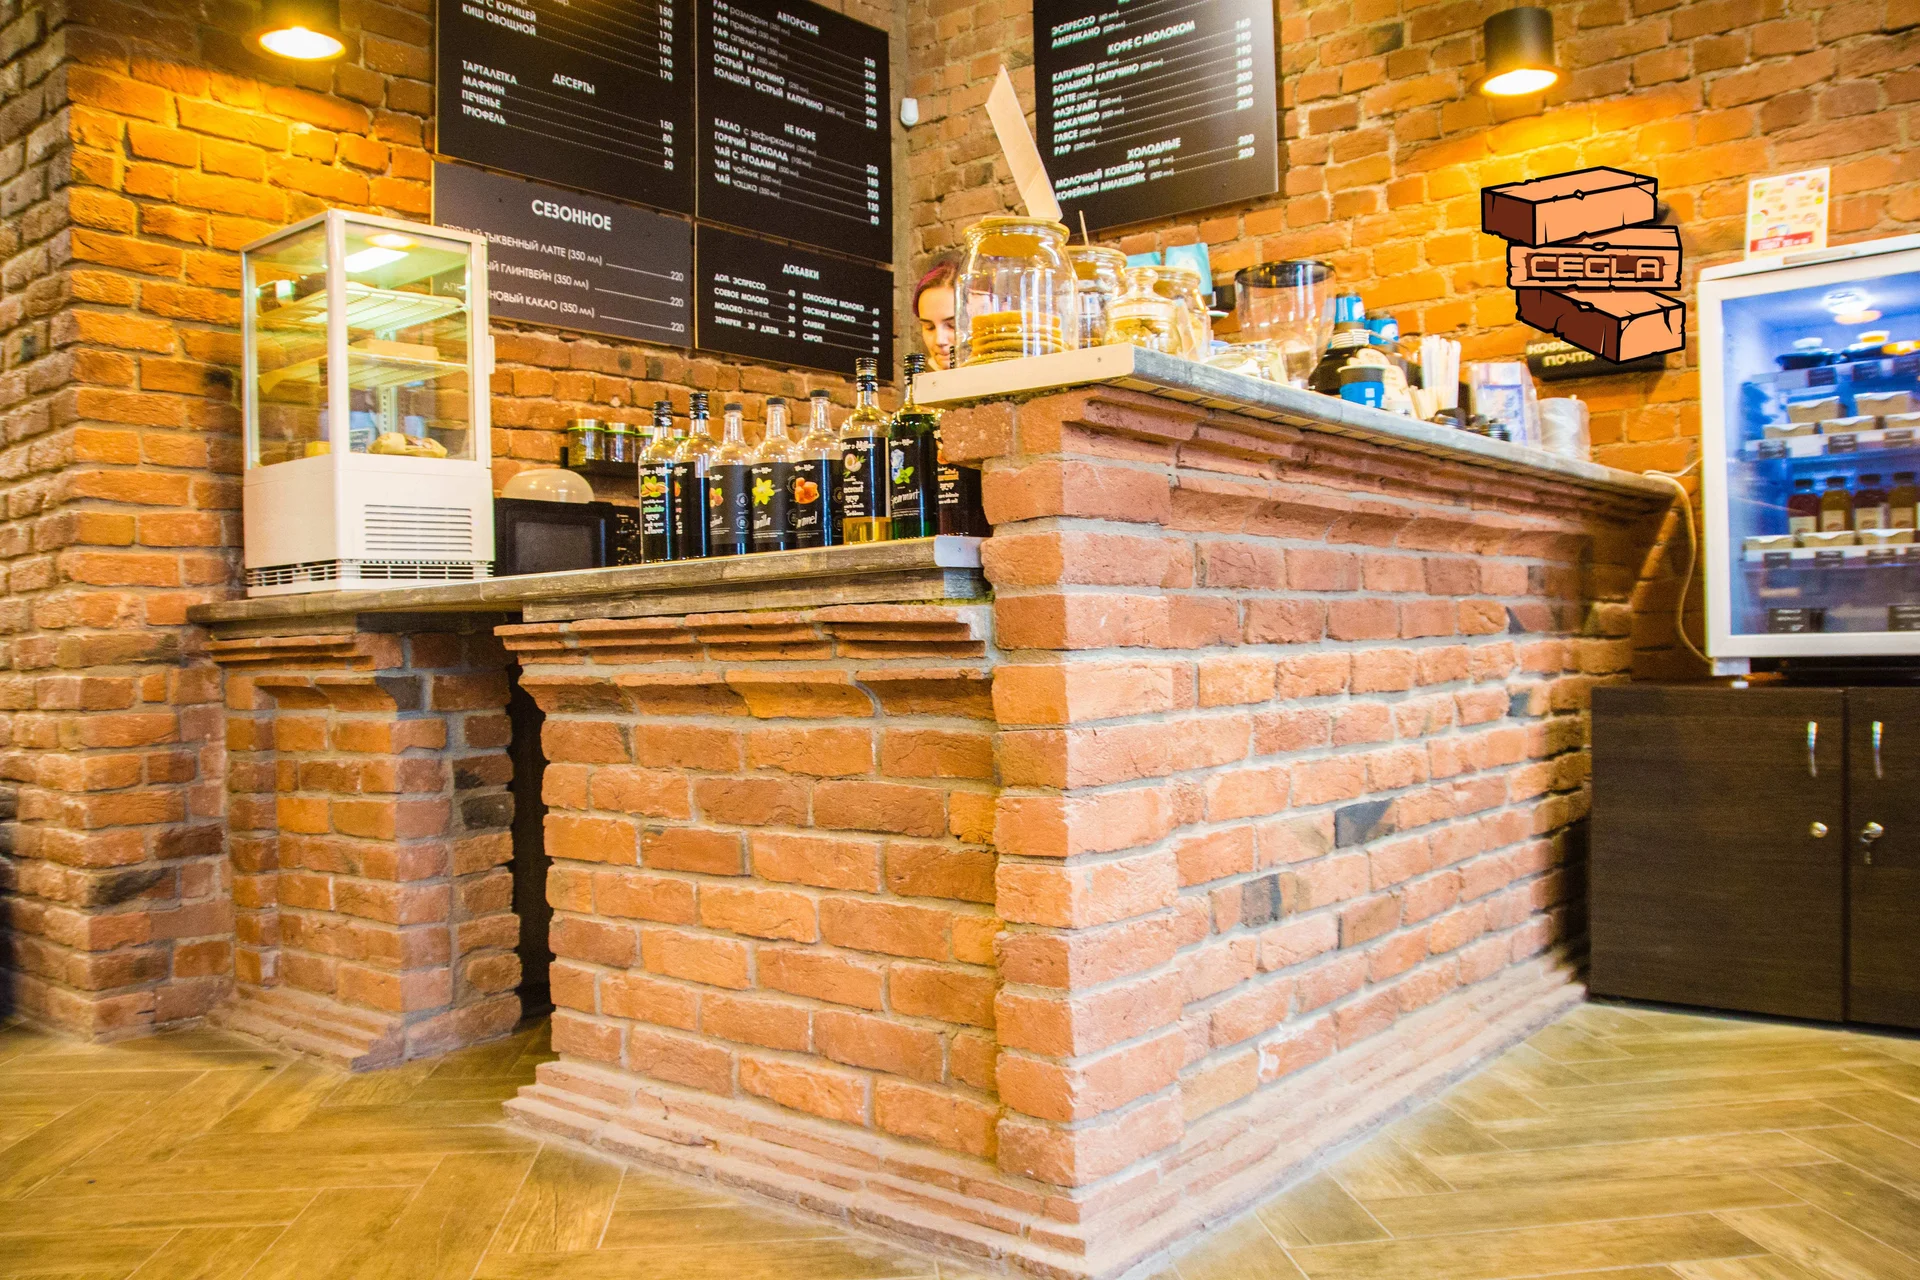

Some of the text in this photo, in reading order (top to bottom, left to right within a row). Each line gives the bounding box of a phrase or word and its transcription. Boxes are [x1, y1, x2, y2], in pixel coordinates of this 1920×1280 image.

[462, 3, 536, 36] КИШ ОВОЩНОЙ
[496, 0, 536, 21] КУРИЦЕЙ
[659, 5, 673, 18] 150
[713, 12, 729, 25] РАФ
[659, 17, 672, 30] 190
[713, 25, 729, 39] РАФ
[777, 11, 820, 36] АВТОРСКИЕ
[1051, 15, 1096, 37] ЭСПРЕССО
[659, 30, 672, 43] 170
[1051, 26, 1101, 49] АМЕРИКАНО
[1106, 20, 1195, 56] КОФЕ С МОЛОКОМ
[658, 42, 672, 55] 150
[713, 39, 739, 56] VEGAN
[659, 56, 673, 68] 190
[713, 53, 744, 71] ОСТРЫЙ
[747, 65, 785, 85] КАПУЧИНО
[552, 73, 595, 94] ДЕСЕРТЫ
[660, 69, 673, 81] 170
[1052, 62, 1095, 84] КАПУЧИНО
[1052, 74, 1094, 96] БОЛЬШОЙ
[1094, 63, 1140, 85] КАПУЧИНО
[462, 75, 505, 95] МАФФИН
[462, 60, 674, 131] ТАРТАЛЕТКА 150
[713, 66, 751, 86] БОЛЬШОЙ
[754, 81, 784, 98] ОСТРЫЙ
[786, 91, 823, 112] КАПУЧИНО
[1053, 92, 1077, 108] ЛАТТЕ
[1053, 99, 1097, 119] ФЛЭТ-УАЙТ
[462, 90, 674, 157] ПЕЧЕНЬЕ 70
[714, 117, 740, 133] КАКАО
[784, 123, 816, 141] НЕ КОФЕ
[1053, 111, 1100, 132] МОКАЧИНО
[462, 104, 674, 171] ТРЮФЕЛЬ 50
[714, 131, 747, 149] ГОРЯЧИЙ
[750, 142, 789, 162] ШОКОЛАД
[1053, 129, 1078, 145] ГЛЯСЕ
[714, 145, 730, 157] ЧАЙ
[741, 153, 776, 170] ЯГОДАМИ
[1053, 144, 1072, 157] РАФ
[1126, 137, 1182, 160] ХОЛОДНЫЕ
[714, 159, 730, 171] ЧАЙ
[1055, 168, 1103, 189] МОЛОЧНЫЙ
[1104, 160, 1146, 179] КОКТЕЙЛЬ
[714, 172, 730, 185] ЧАЙ
[1055, 181, 1100, 201] КОФЕЙНЫЙ
[1100, 172, 1147, 192] МИЛКШЕЙК
[531, 199, 612, 231] СЕЗОННОЕ
[484, 232, 684, 282] ТЫКВЕННЫЙ ЛАТТЕ (350 мл) 220
[782, 263, 820, 280] ДОБАВКИ
[500, 263, 552, 281] ГЛИНТВЕЙН
[554, 273, 572, 286] (350
[573, 279, 589, 290] мл)
[670, 296, 684, 308] 220
[732, 277, 767, 290] ЭСПРЕССО
[714, 301, 743, 314] МОЛОКО
[741, 293, 769, 305] МОЛОКО
[525, 296, 558, 311] КАКАО
[560, 301, 578, 314] (350
[578, 306, 595, 318] мл)
[670, 321, 684, 333] 220
